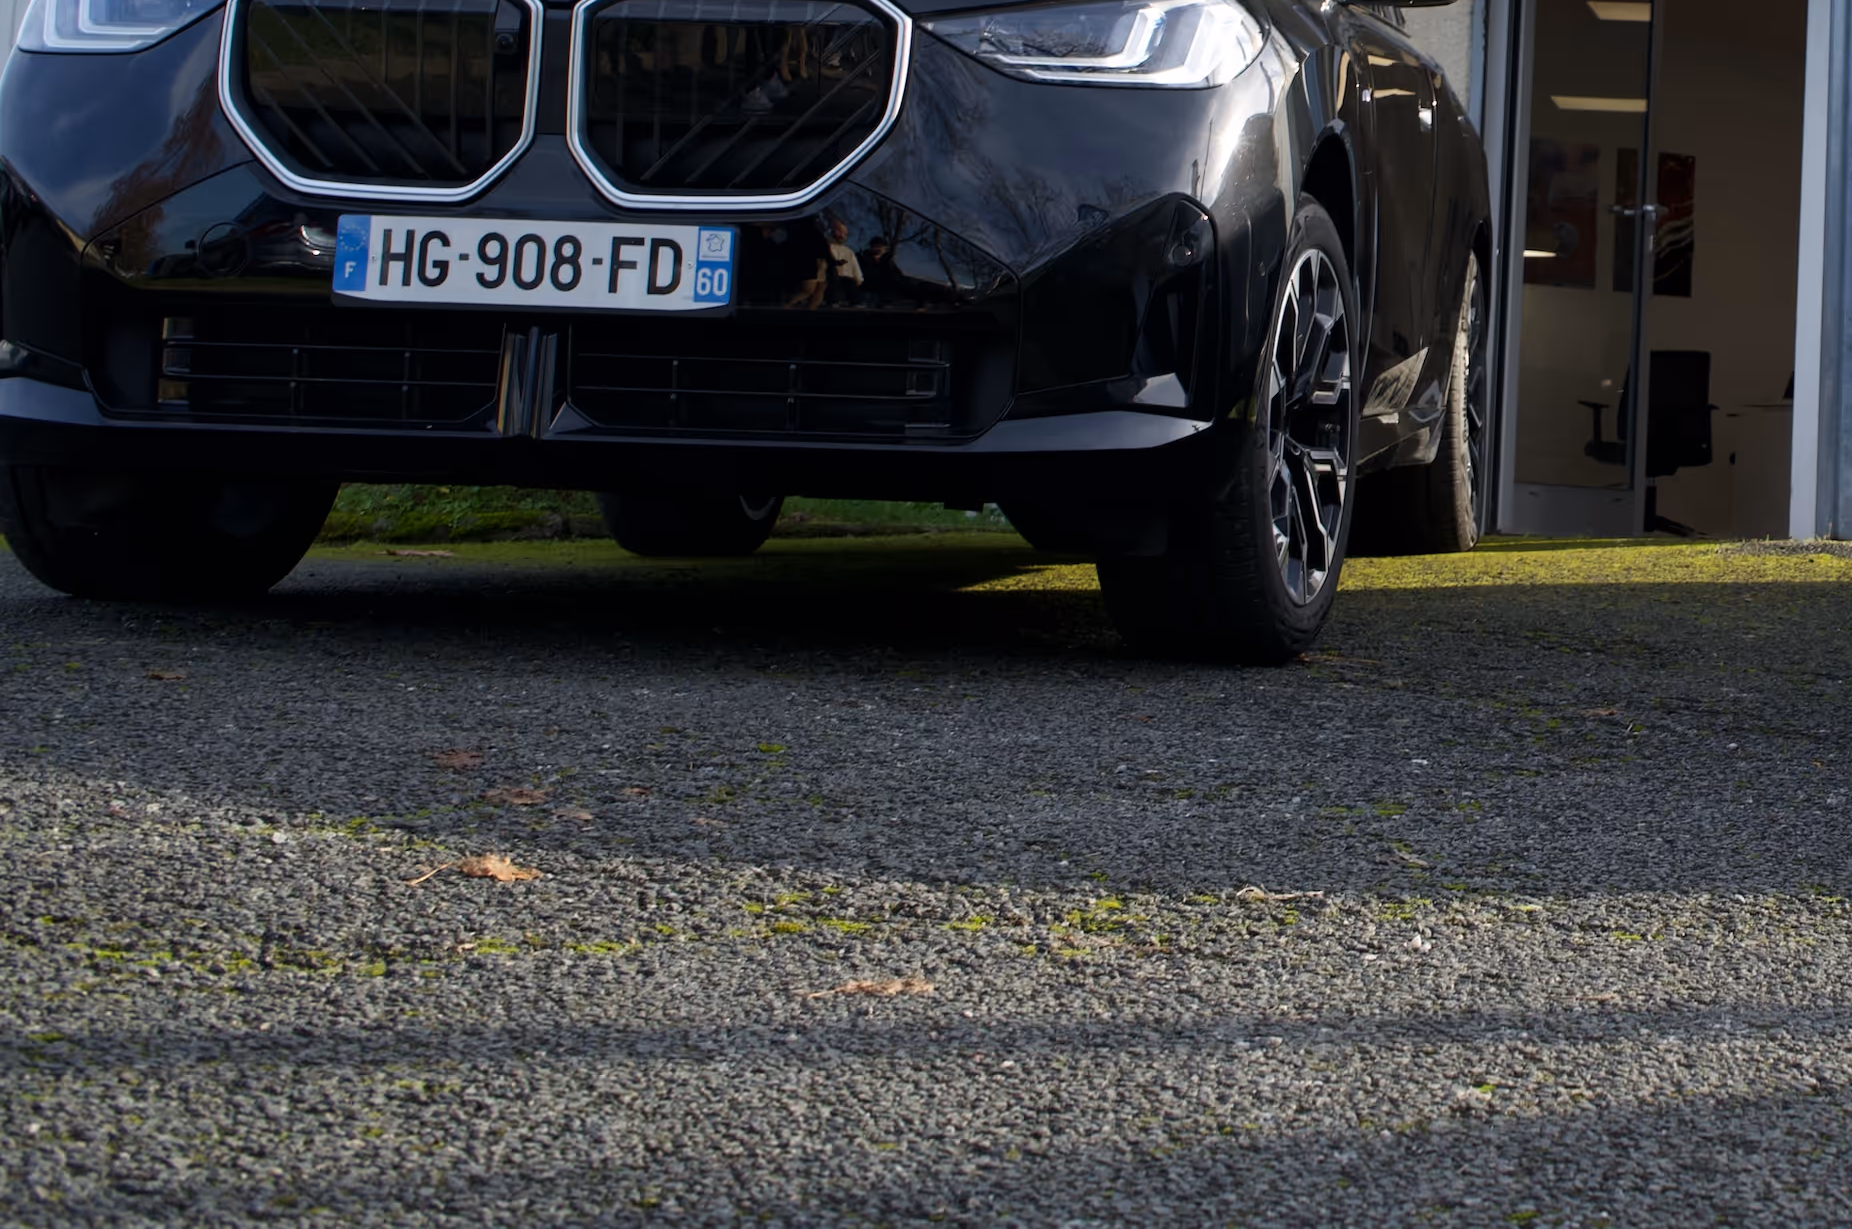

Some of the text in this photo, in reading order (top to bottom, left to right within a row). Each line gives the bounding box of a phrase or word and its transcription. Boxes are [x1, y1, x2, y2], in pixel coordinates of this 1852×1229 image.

[343, 228, 729, 297] F HG-908-FD 60
